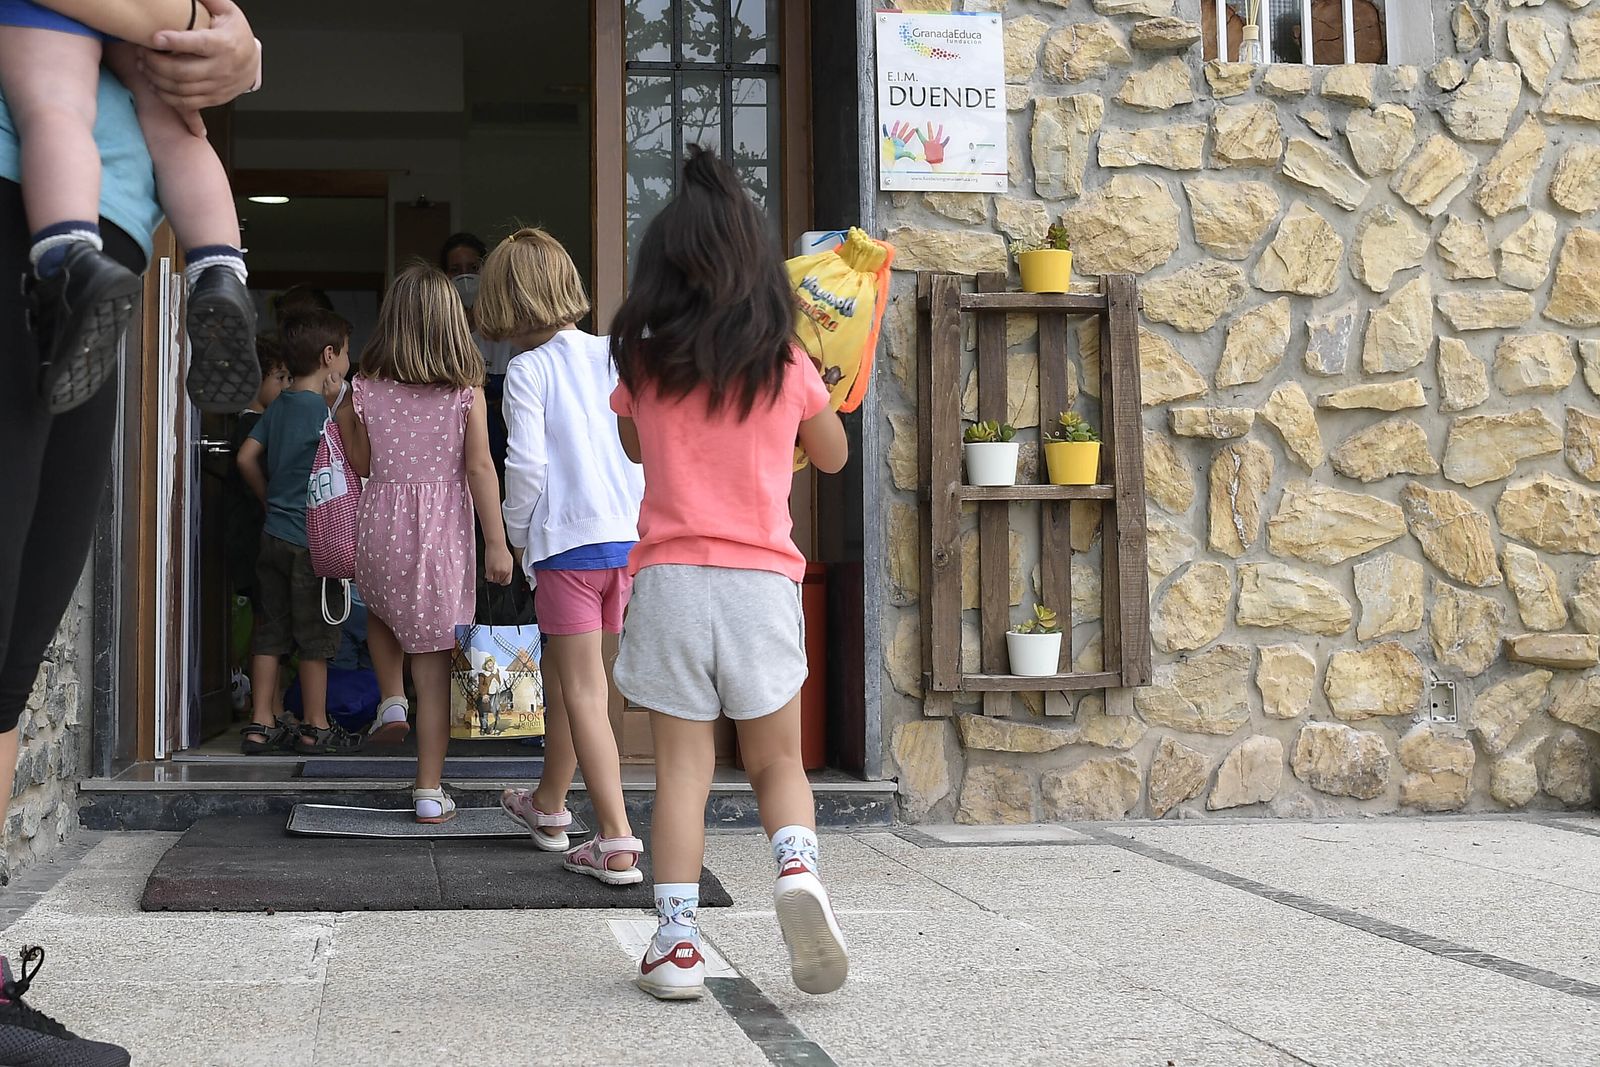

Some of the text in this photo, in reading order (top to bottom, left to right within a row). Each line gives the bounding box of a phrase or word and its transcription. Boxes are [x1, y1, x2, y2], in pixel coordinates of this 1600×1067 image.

[912, 27, 982, 40] GranadaEduca
[887, 72, 919, 82] E.I.M.
[889, 85, 996, 109] DUENDE
[675, 948, 695, 959] NIKE
